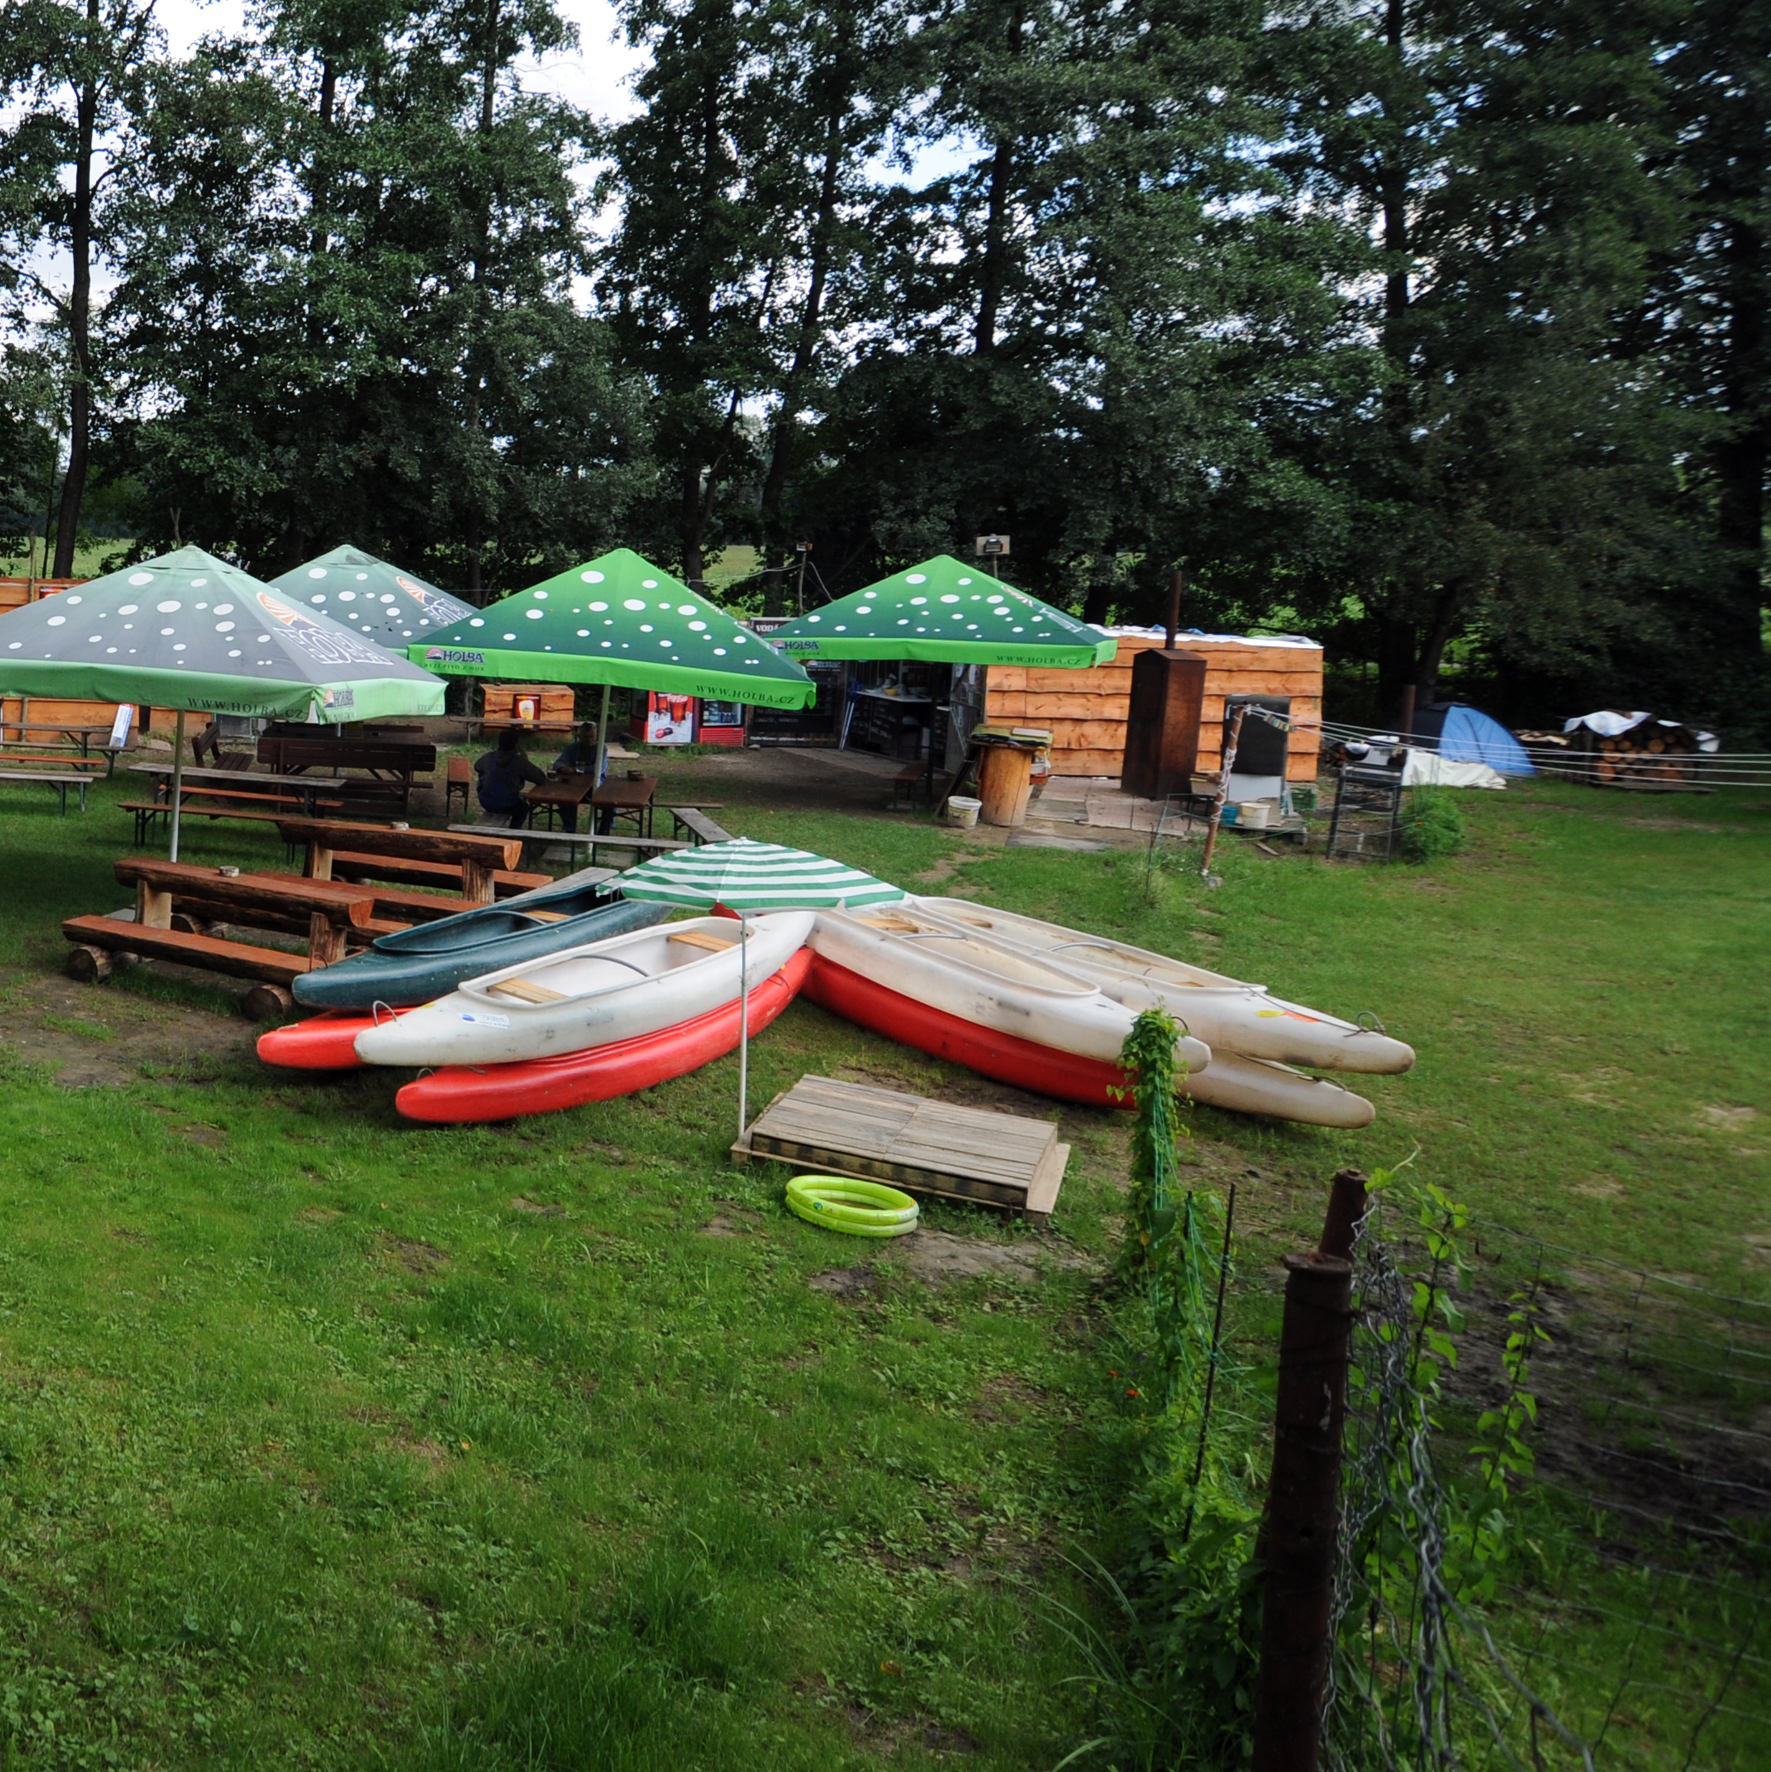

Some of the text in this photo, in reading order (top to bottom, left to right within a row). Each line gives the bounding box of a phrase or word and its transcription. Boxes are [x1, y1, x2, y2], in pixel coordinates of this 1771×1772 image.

[784, 641, 819, 650] HOLBA
[444, 650, 485, 663] HOLBA
[997, 655, 1082, 665] WWW.HOLBA.CZ
[696, 685, 796, 704] WWW.HOLBA.CZ
[187, 697, 304, 720] WWW.HOLBA.CZ
